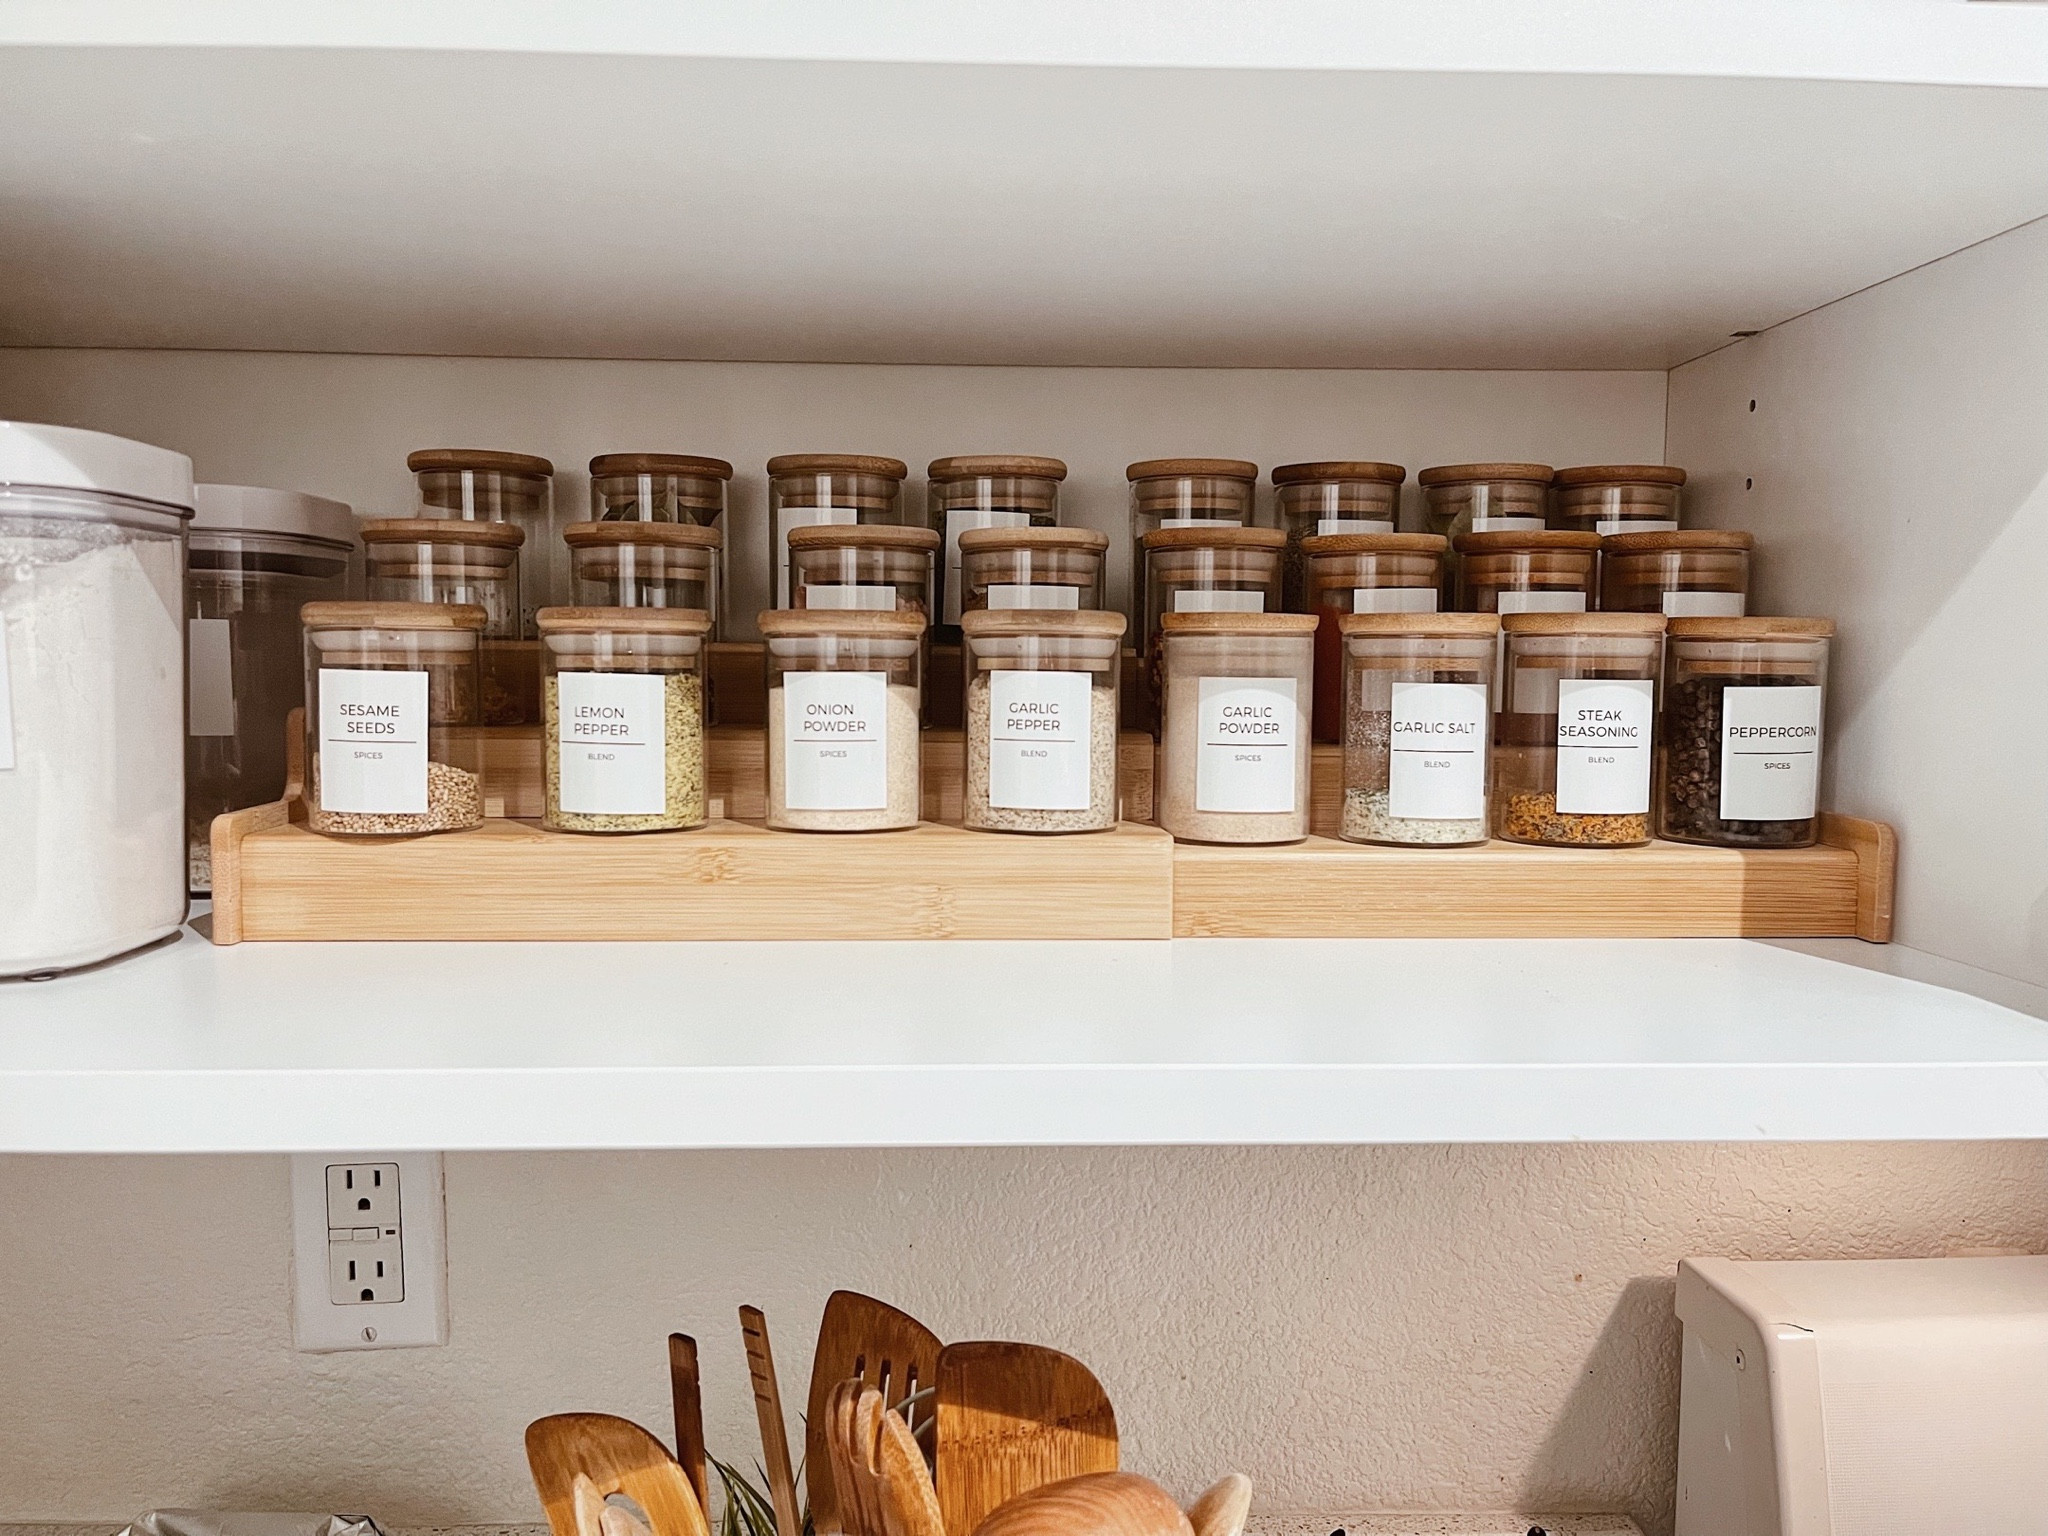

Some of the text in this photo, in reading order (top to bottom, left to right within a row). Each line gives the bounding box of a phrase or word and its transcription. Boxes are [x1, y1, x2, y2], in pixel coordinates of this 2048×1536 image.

[340, 704, 400, 718] SESAME
[574, 706, 625, 719] LEMON
[807, 704, 853, 715] ONION
[1009, 702, 1059, 714] GARLIC
[1223, 706, 1272, 718] GARLIC
[1578, 710, 1621, 721] STEAK
[347, 721, 395, 734] SEEDS
[574, 723, 629, 736] PEPPER
[804, 720, 866, 732] POWDER
[1007, 718, 1060, 731] PEPPER
[1219, 722, 1279, 734] POWDER
[1393, 721, 1475, 734] GARLIC SALT
[1560, 726, 1638, 738] SEASONING
[1729, 726, 1817, 738] PEPPERCORN
[354, 751, 383, 759] SPICES
[588, 753, 615, 761] BLEND
[820, 750, 847, 758] SPICES
[1235, 754, 1261, 762] SPICES
[1424, 760, 1450, 768] BLEND
[1764, 762, 1790, 770] SPICES
